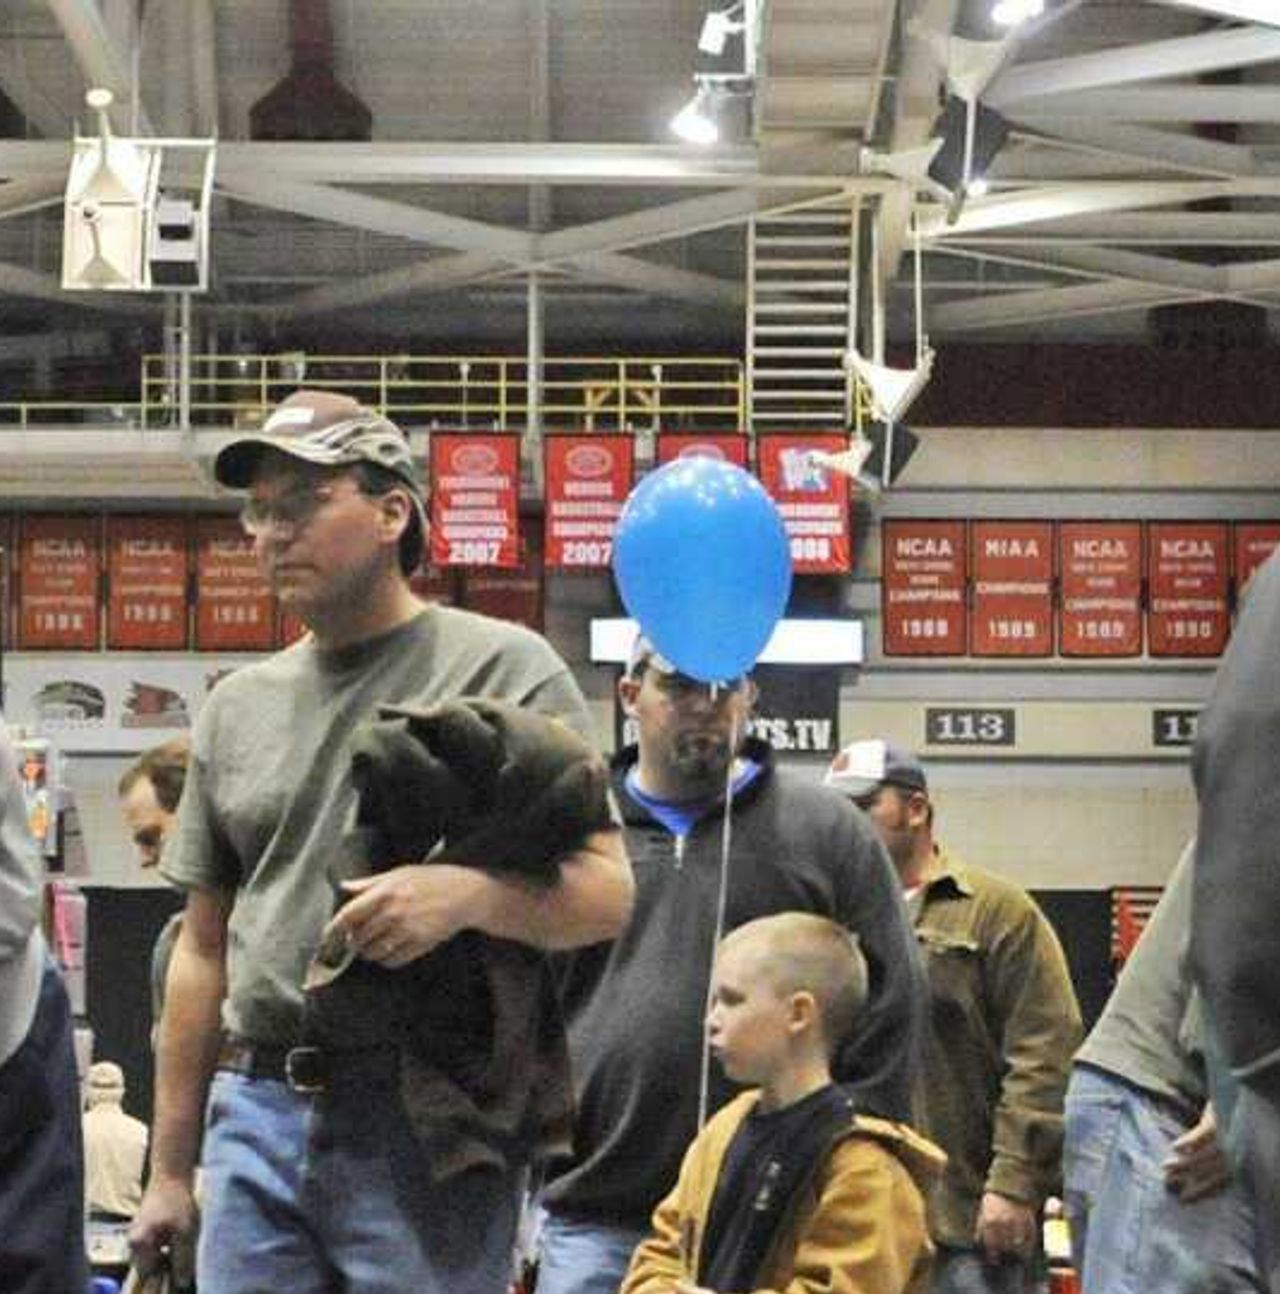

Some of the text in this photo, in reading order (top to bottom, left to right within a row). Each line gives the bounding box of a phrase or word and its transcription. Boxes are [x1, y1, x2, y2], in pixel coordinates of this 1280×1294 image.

[896, 538, 953, 557] NCAA
[1073, 540, 1128, 558] NCAA
[1160, 540, 1214, 558] NCAA
[936, 712, 1005, 740] 113
[1162, 715, 1198, 741] 11
